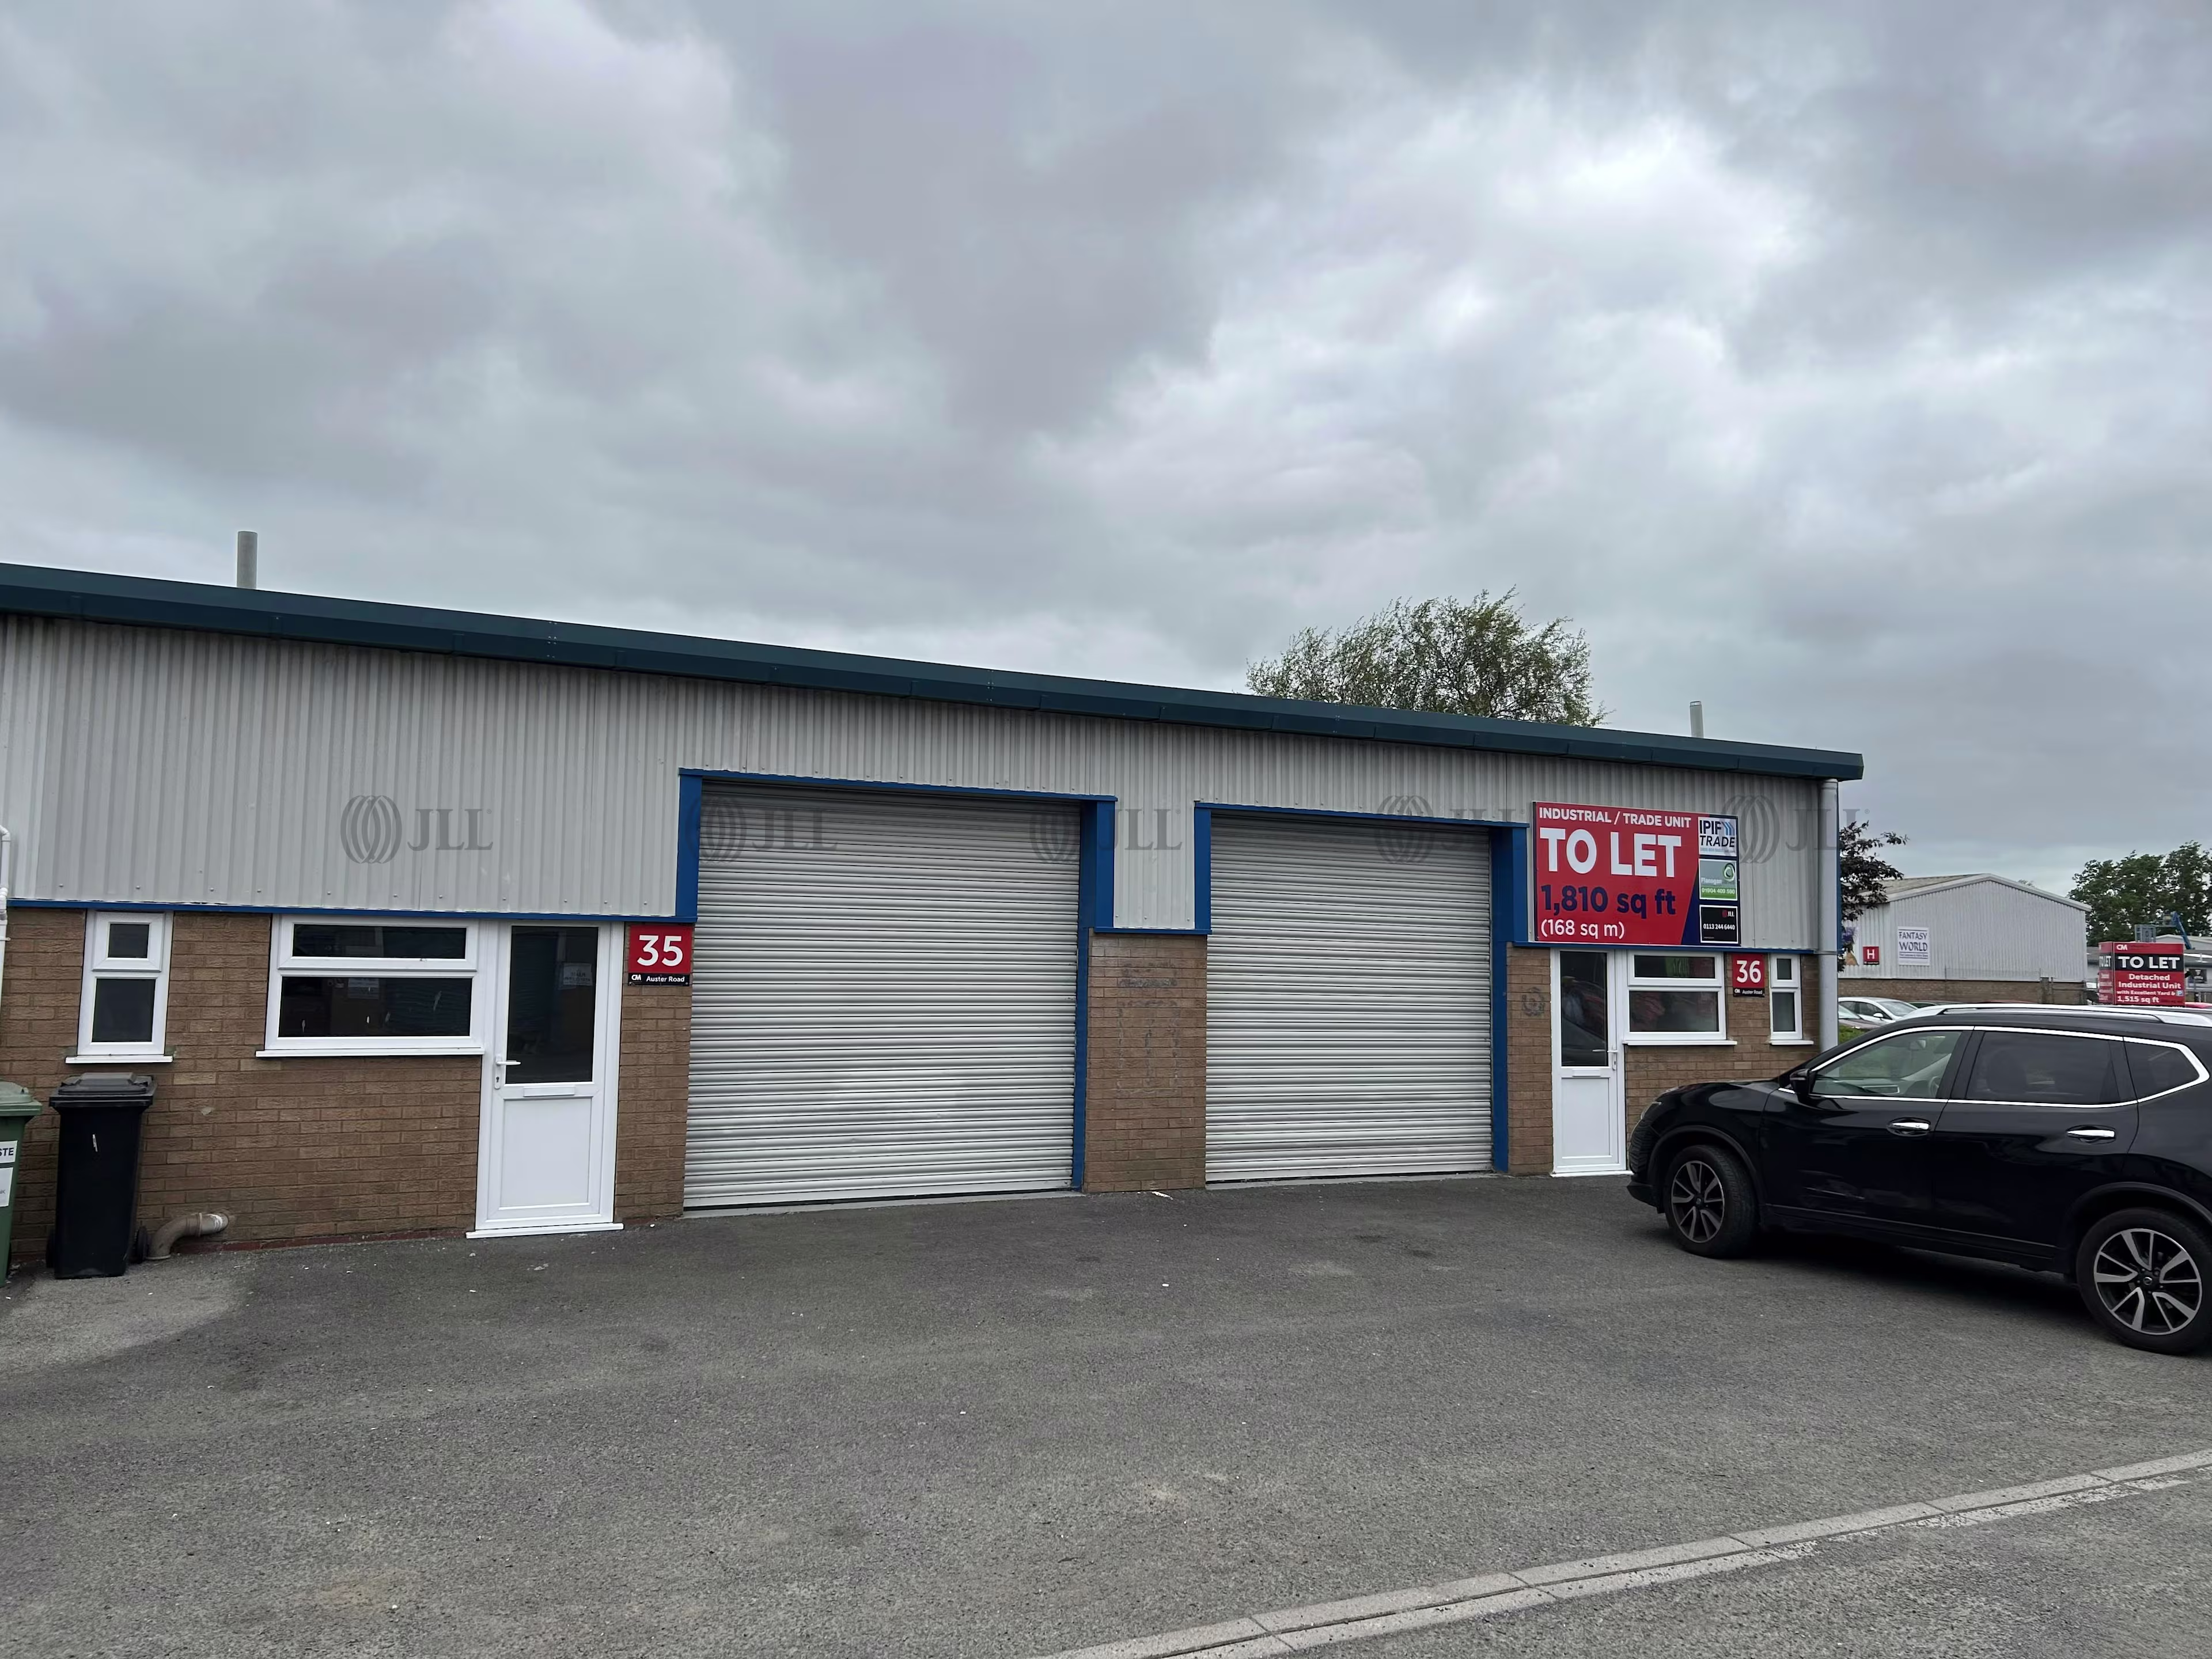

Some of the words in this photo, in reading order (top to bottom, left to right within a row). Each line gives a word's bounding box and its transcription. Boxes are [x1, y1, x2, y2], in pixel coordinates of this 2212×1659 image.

[1539, 807, 1612, 823] INDUSTRIAL
[1613, 811, 1621, 825] /
[1623, 813, 1662, 827] TRADE
[1664, 816, 1691, 828] UNIT
[1699, 820, 1722, 835] IPIF
[1699, 835, 1735, 847] TRADE
[1539, 827, 1597, 874] TO
[1610, 831, 1682, 878] LET
[1541, 884, 1609, 916] 1,810
[1616, 892, 1647, 919] sq
[1654, 888, 1676, 915] ft
[1540, 918, 1575, 938] (168
[1580, 923, 1599, 940] sq
[1604, 921, 1625, 940] m)
[1898, 931, 1927, 940] FANTASY
[637, 934, 683, 967] 35
[1866, 949, 1875, 960] H
[1899, 941, 1928, 951] WORLD
[1736, 960, 1762, 983] 36
[2118, 956, 2144, 969] TO
[2148, 956, 2180, 969] LET
